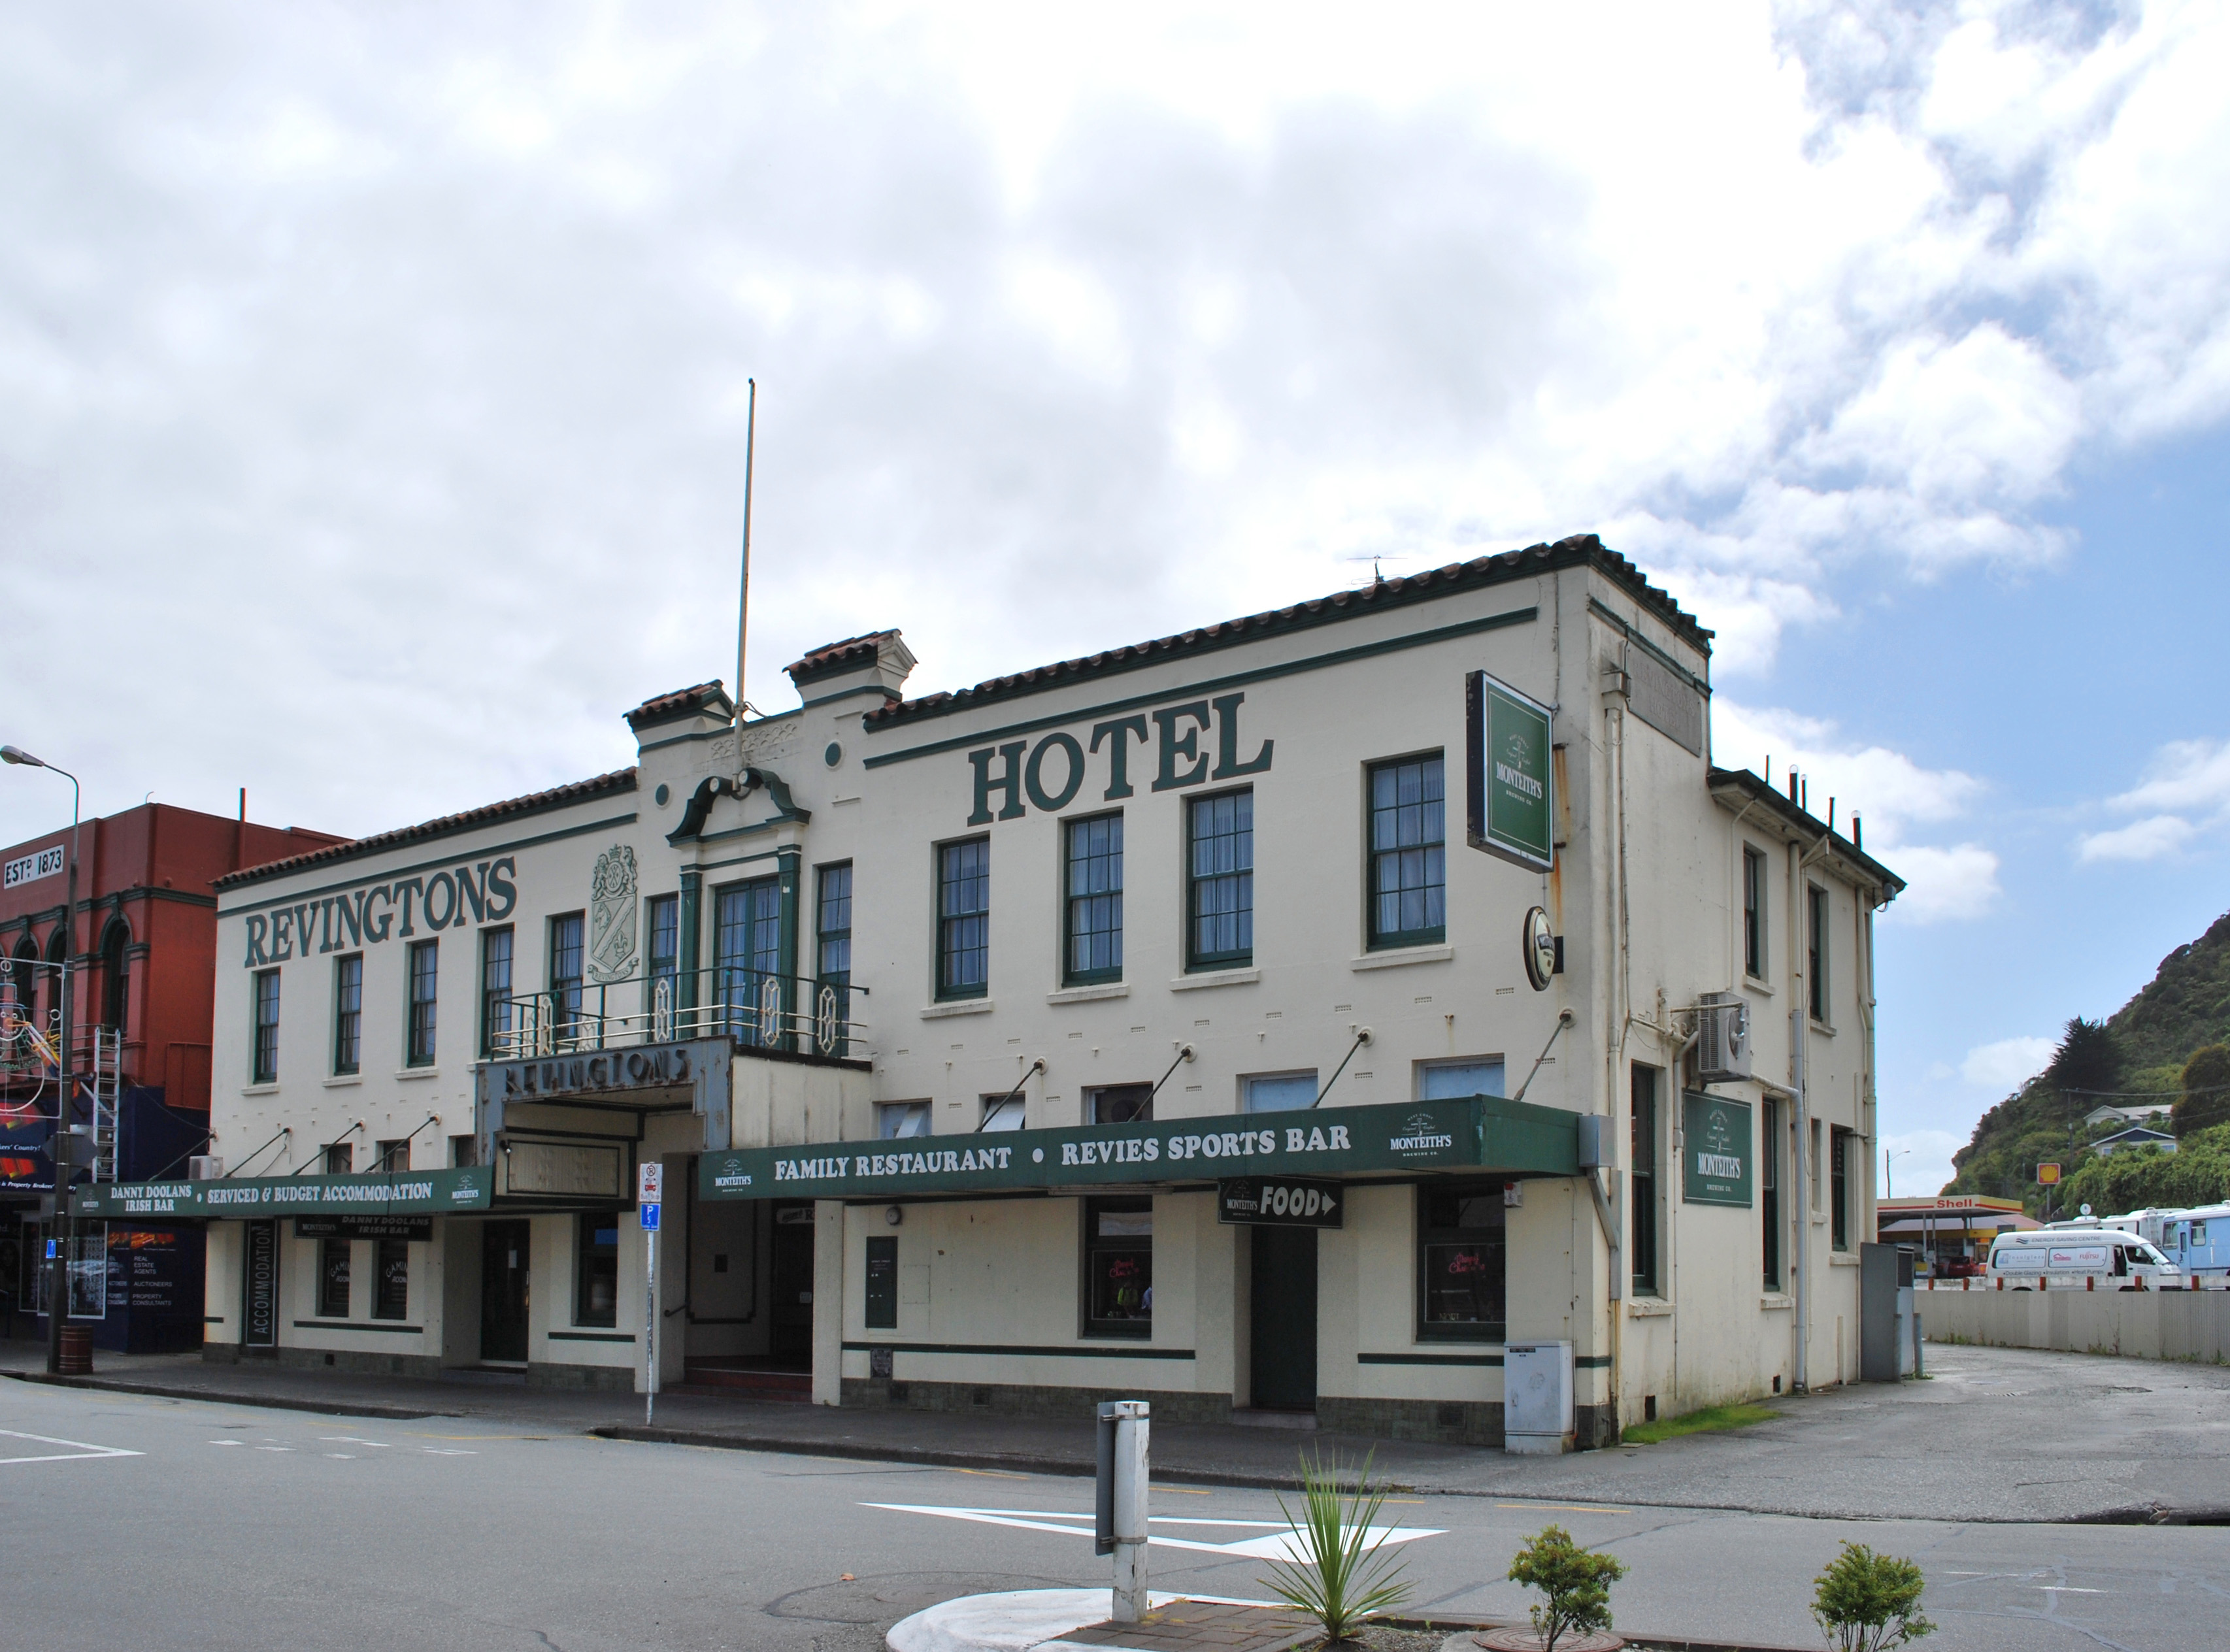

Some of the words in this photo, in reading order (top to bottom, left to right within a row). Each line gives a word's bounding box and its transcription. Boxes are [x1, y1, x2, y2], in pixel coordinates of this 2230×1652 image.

[967, 691, 1274, 827] HOTEL
[1496, 761, 1542, 799] MONTEITH'S
[38, 850, 62, 875] 1873
[244, 856, 517, 968] REVINGTONS
[506, 1049, 691, 1095] REVINGTONS
[1061, 1138, 1159, 1165] REVIES
[1168, 1131, 1276, 1159] SPORTS
[1286, 1125, 1351, 1152] BAR
[1390, 1134, 1452, 1150] MONTEITH'S
[774, 1157, 850, 1180] FAMILY
[856, 1147, 1012, 1177] RESTAURANT
[1697, 1152, 1740, 1179] MONTEITH'S
[110, 1186, 144, 1198] DANNY
[146, 1185, 191, 1198] DOOLANS
[715, 1176, 751, 1186] MONTEITH'S
[207, 1188, 259, 1204] SERVICED
[262, 1186, 271, 1202] &
[274, 1185, 320, 1202] BUDGET
[322, 1182, 433, 1201] ACCOMMODATION
[1227, 1198, 1257, 1210] MONTEITH'S
[1260, 1186, 1320, 1216] FOOD
[1937, 1199, 1972, 1208] Shell
[125, 1200, 152, 1212] IRISH
[154, 1199, 175, 1211] BAR
[647, 1206, 654, 1215] P
[342, 1215, 380, 1225] DANNY
[381, 1216, 430, 1226] DOOLANS
[254, 1227, 271, 1334] ACCOMMODATION
[386, 1261, 407, 1278] GAMIN
